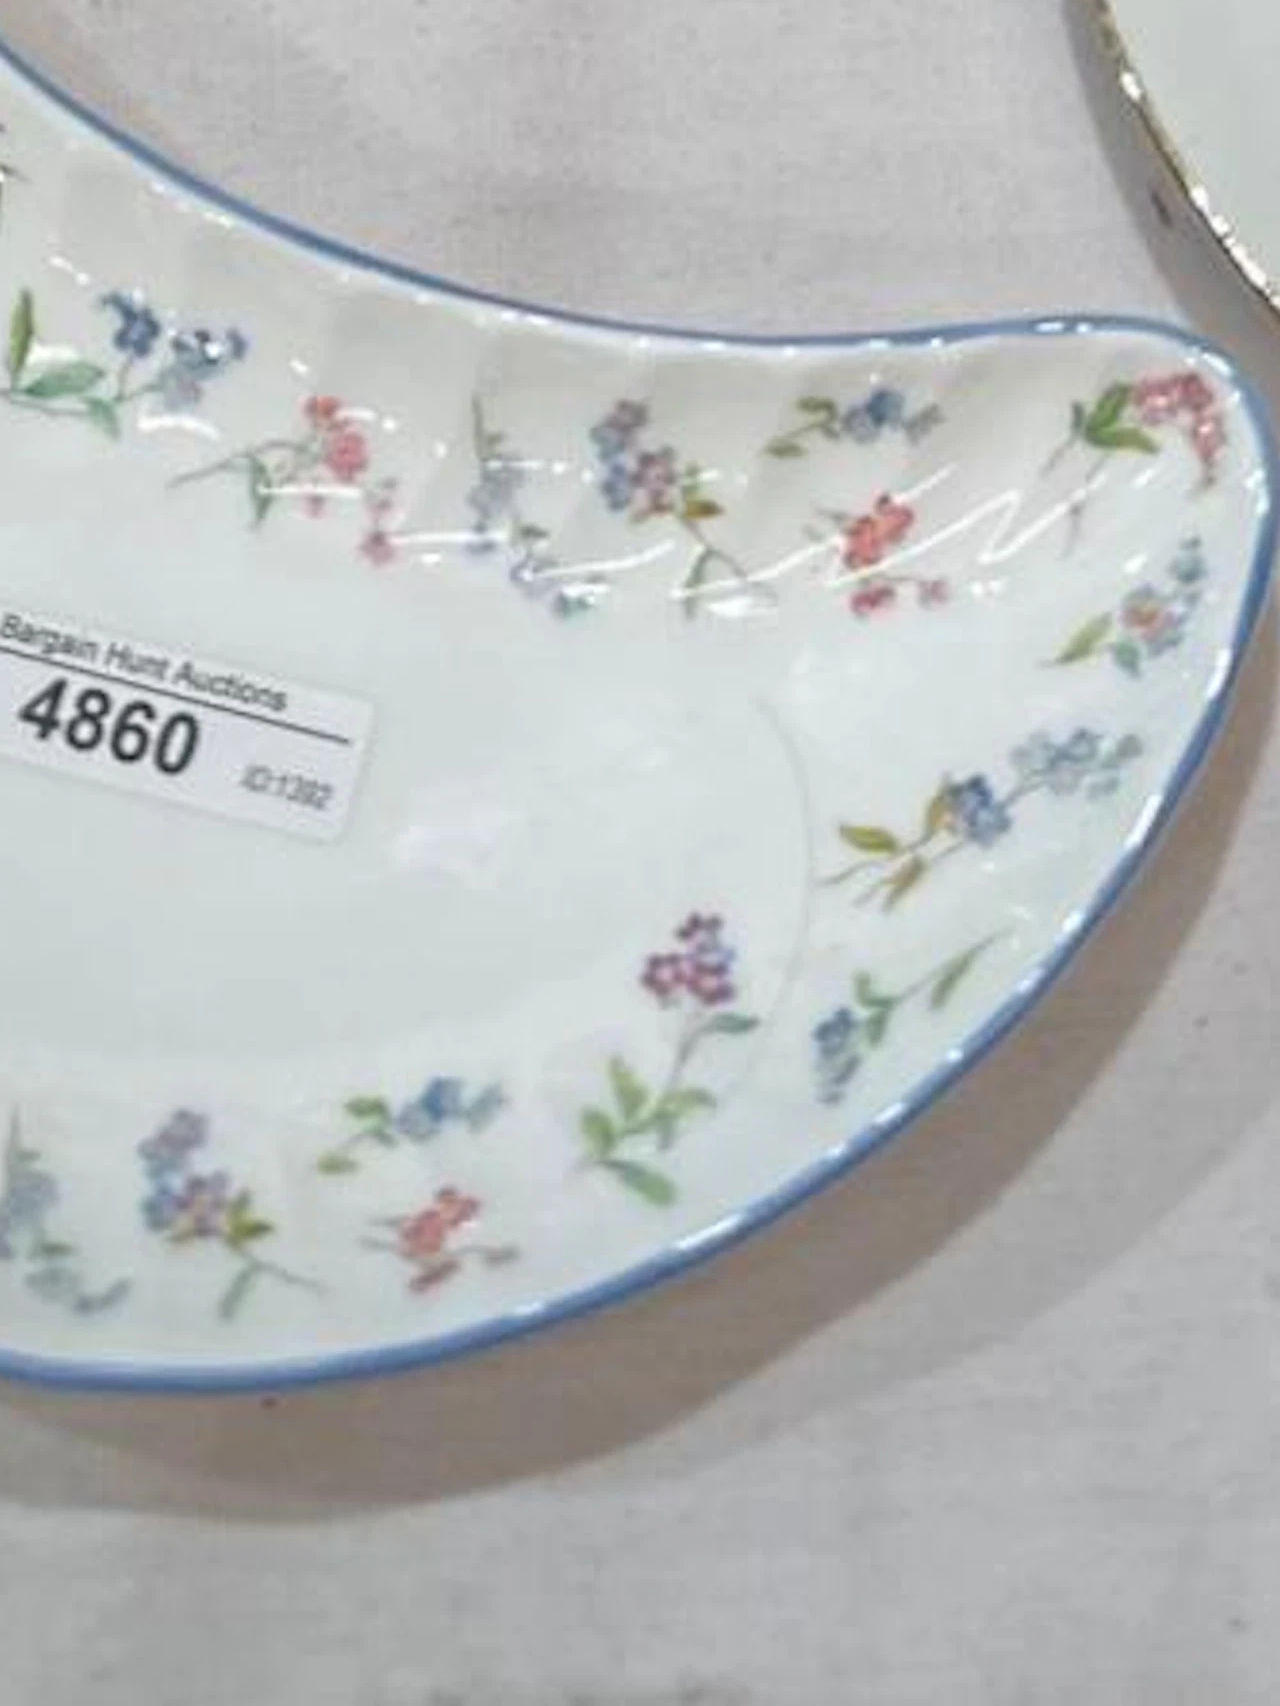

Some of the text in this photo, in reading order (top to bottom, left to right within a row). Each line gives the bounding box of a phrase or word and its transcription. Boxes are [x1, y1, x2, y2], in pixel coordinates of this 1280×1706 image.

[105, 640, 169, 681] Hunt
[173, 660, 288, 712] Auctions
[17, 676, 200, 777] 4860
